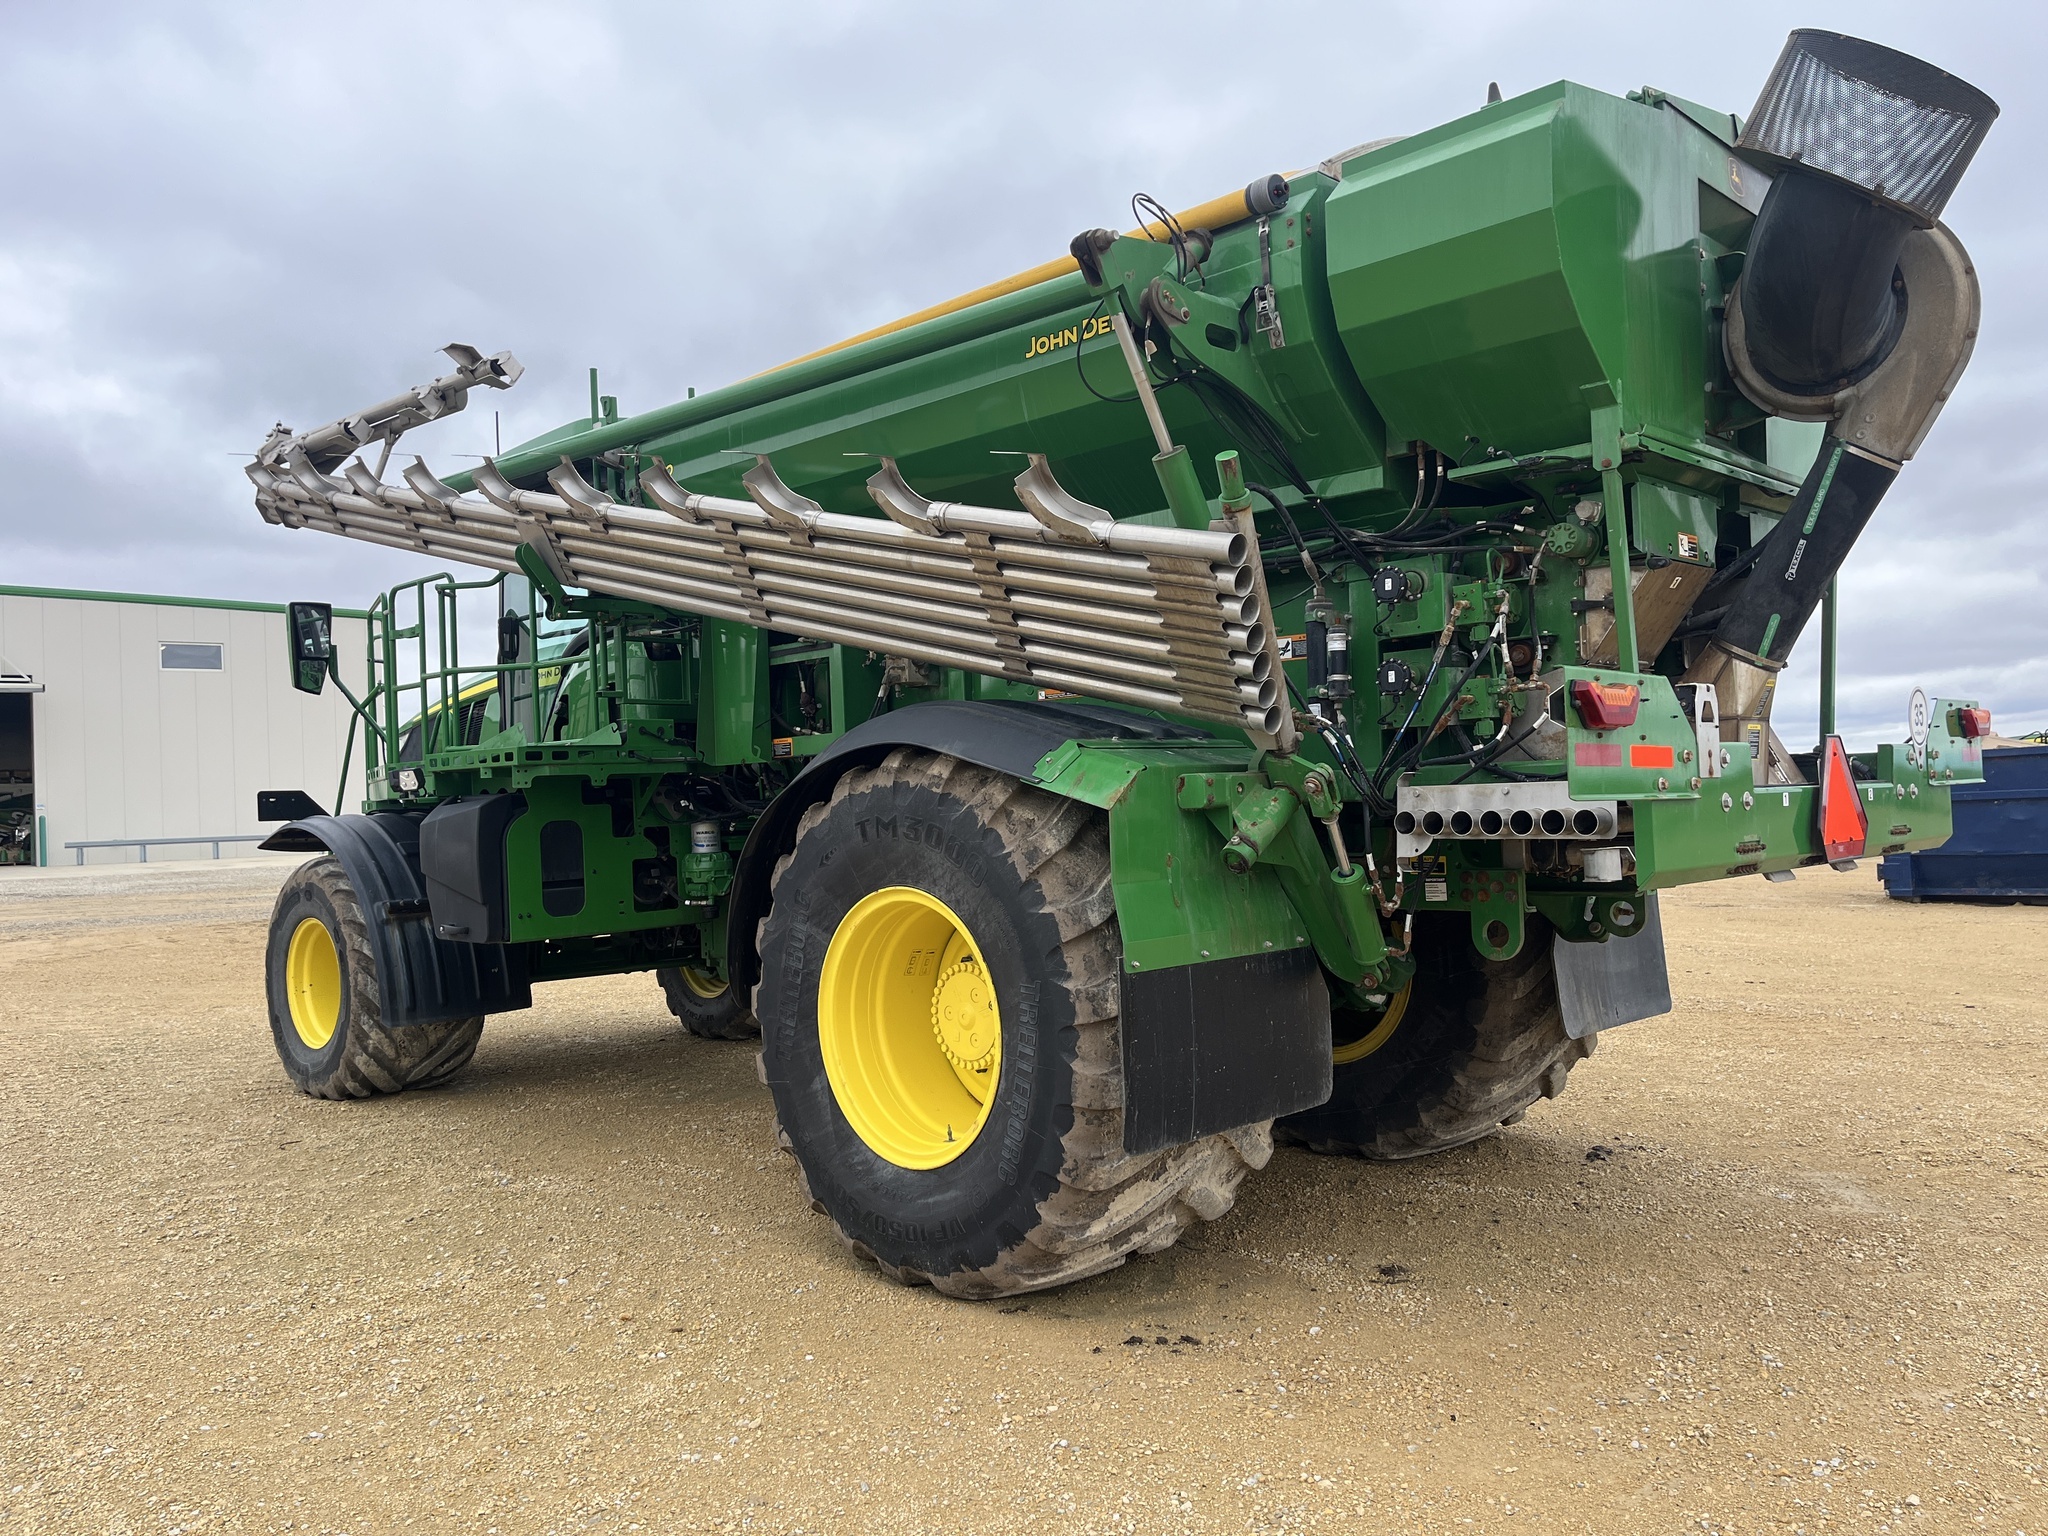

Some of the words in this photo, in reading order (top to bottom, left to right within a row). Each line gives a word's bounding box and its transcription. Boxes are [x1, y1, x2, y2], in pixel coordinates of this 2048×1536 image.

[1025, 325, 1079, 359] JOHN
[1806, 502, 1821, 529] TEX-FLO
[1790, 540, 1805, 571] TEXCEL
[1914, 703, 1924, 727] 35
[855, 814, 988, 887] TM3000
[776, 888, 812, 1062] TRELLEBORG
[998, 980, 1042, 1187] TRELLEBORG
